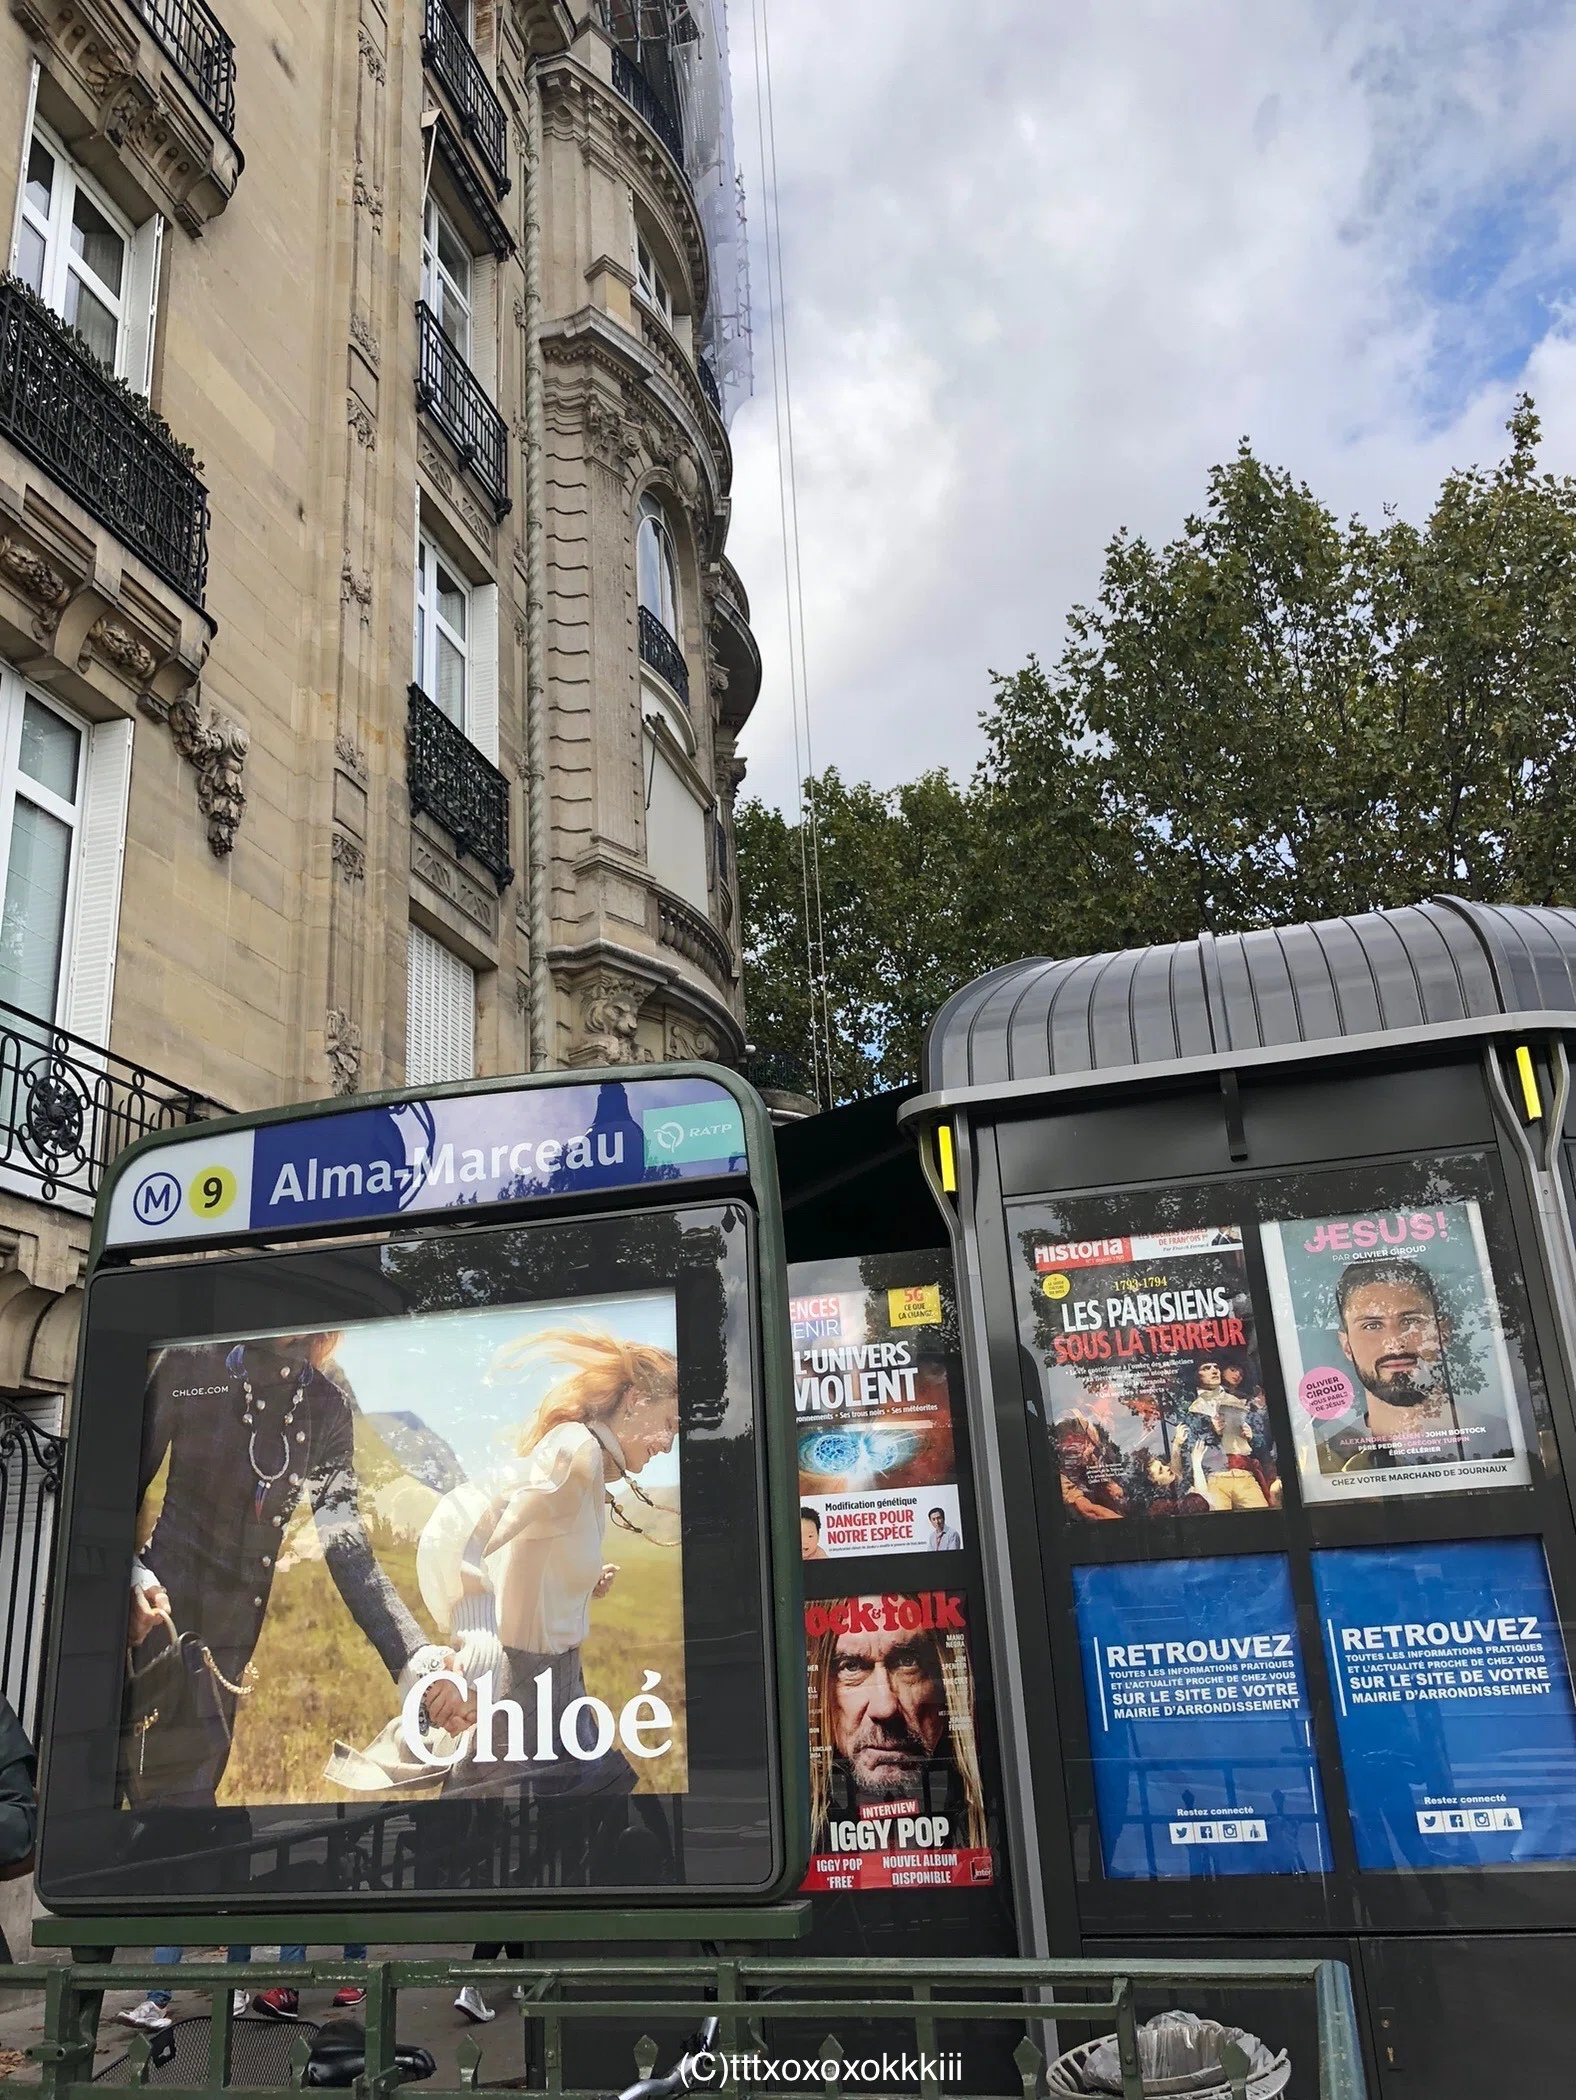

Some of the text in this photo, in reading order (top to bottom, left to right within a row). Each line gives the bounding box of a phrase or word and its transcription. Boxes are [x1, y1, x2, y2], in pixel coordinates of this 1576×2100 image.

[689, 1123, 732, 1137] RATP
[269, 1131, 625, 1206] Alma-Marceau
[143, 1180, 171, 1215] M
[202, 1177, 224, 1209] 9
[1304, 1211, 1448, 1253] JESUS!
[1332, 1253, 1350, 1262] PAR
[1352, 1248, 1388, 1260] OLIVIER
[1390, 1245, 1427, 1256] GIROUD
[1113, 1275, 1168, 1291] 1793-1794
[904, 1287, 924, 1303] 5G
[1061, 1287, 1230, 1333] LES PARISIENS
[794, 1319, 840, 1339] ENIR
[1053, 1318, 1246, 1364] SOUS LA TERREUR
[794, 1341, 911, 1375] L'UNIVERS
[172, 1386, 229, 1398] CHLOE.COM
[794, 1367, 919, 1412] VIOLENT
[1306, 1376, 1339, 1390] OLIVIER
[1306, 1383, 1345, 1399] GIROUD
[852, 1410, 868, 1418] trous
[869, 1408, 886, 1416] noirs
[891, 1406, 902, 1414] Ses
[903, 1404, 938, 1414] météorites
[1340, 1435, 1387, 1446] ALEXANDRE
[1449, 1426, 1487, 1436] BOSTOCK
[1378, 1441, 1403, 1450] PEDRO
[1443, 1436, 1470, 1445] TURPIN
[1389, 1446, 1441, 1456] ÉRIC CÉLÉRIER
[1331, 1465, 1508, 1487] CHEZ VOTRE MARCHAND DE JOURNAUX
[825, 1497, 917, 1511] Modification génétique
[826, 1509, 914, 1528] DANGER POUR
[828, 1524, 913, 1544] NOTRE ESPÈCE
[1341, 1616, 1541, 1651] RETROUVEZ
[1107, 1634, 1293, 1668] RETROUVEZ
[1345, 1643, 1544, 1663] TOUTES LES INFORMATIONS PRATIQUES
[1109, 1660, 1295, 1680] TOUTES LES INFORMATIONS PRATIQUES
[1348, 1654, 1546, 1673] ET L'ACTUALITÉ PROCHE DE CHEZ VOUS
[1111, 1671, 1296, 1690] ET L'ACTUALITÉ PROCHE DE CHEZ VOUS
[1350, 1666, 1549, 1690] SUR LE SITE DE VOTRE
[1112, 1682, 1299, 1706] SUR LE SITE DE VOTRE
[1352, 1682, 1551, 1704] MAIRIE D'ARRONDISSEMENT
[400, 1669, 673, 1765] Chloé
[1114, 1698, 1300, 1719] MAIRIE D'ARRONDISSEMENT
[1424, 1794, 1507, 1805] Restez connecté
[862, 1801, 916, 1819] INTERVIEW
[1177, 1806, 1254, 1816] Restez connecté
[830, 1816, 950, 1851] IGGY POP
[817, 1854, 957, 1872] IGGY POP NOUVEL ALBUM
[892, 1871, 951, 1885] DISPONIBLE
